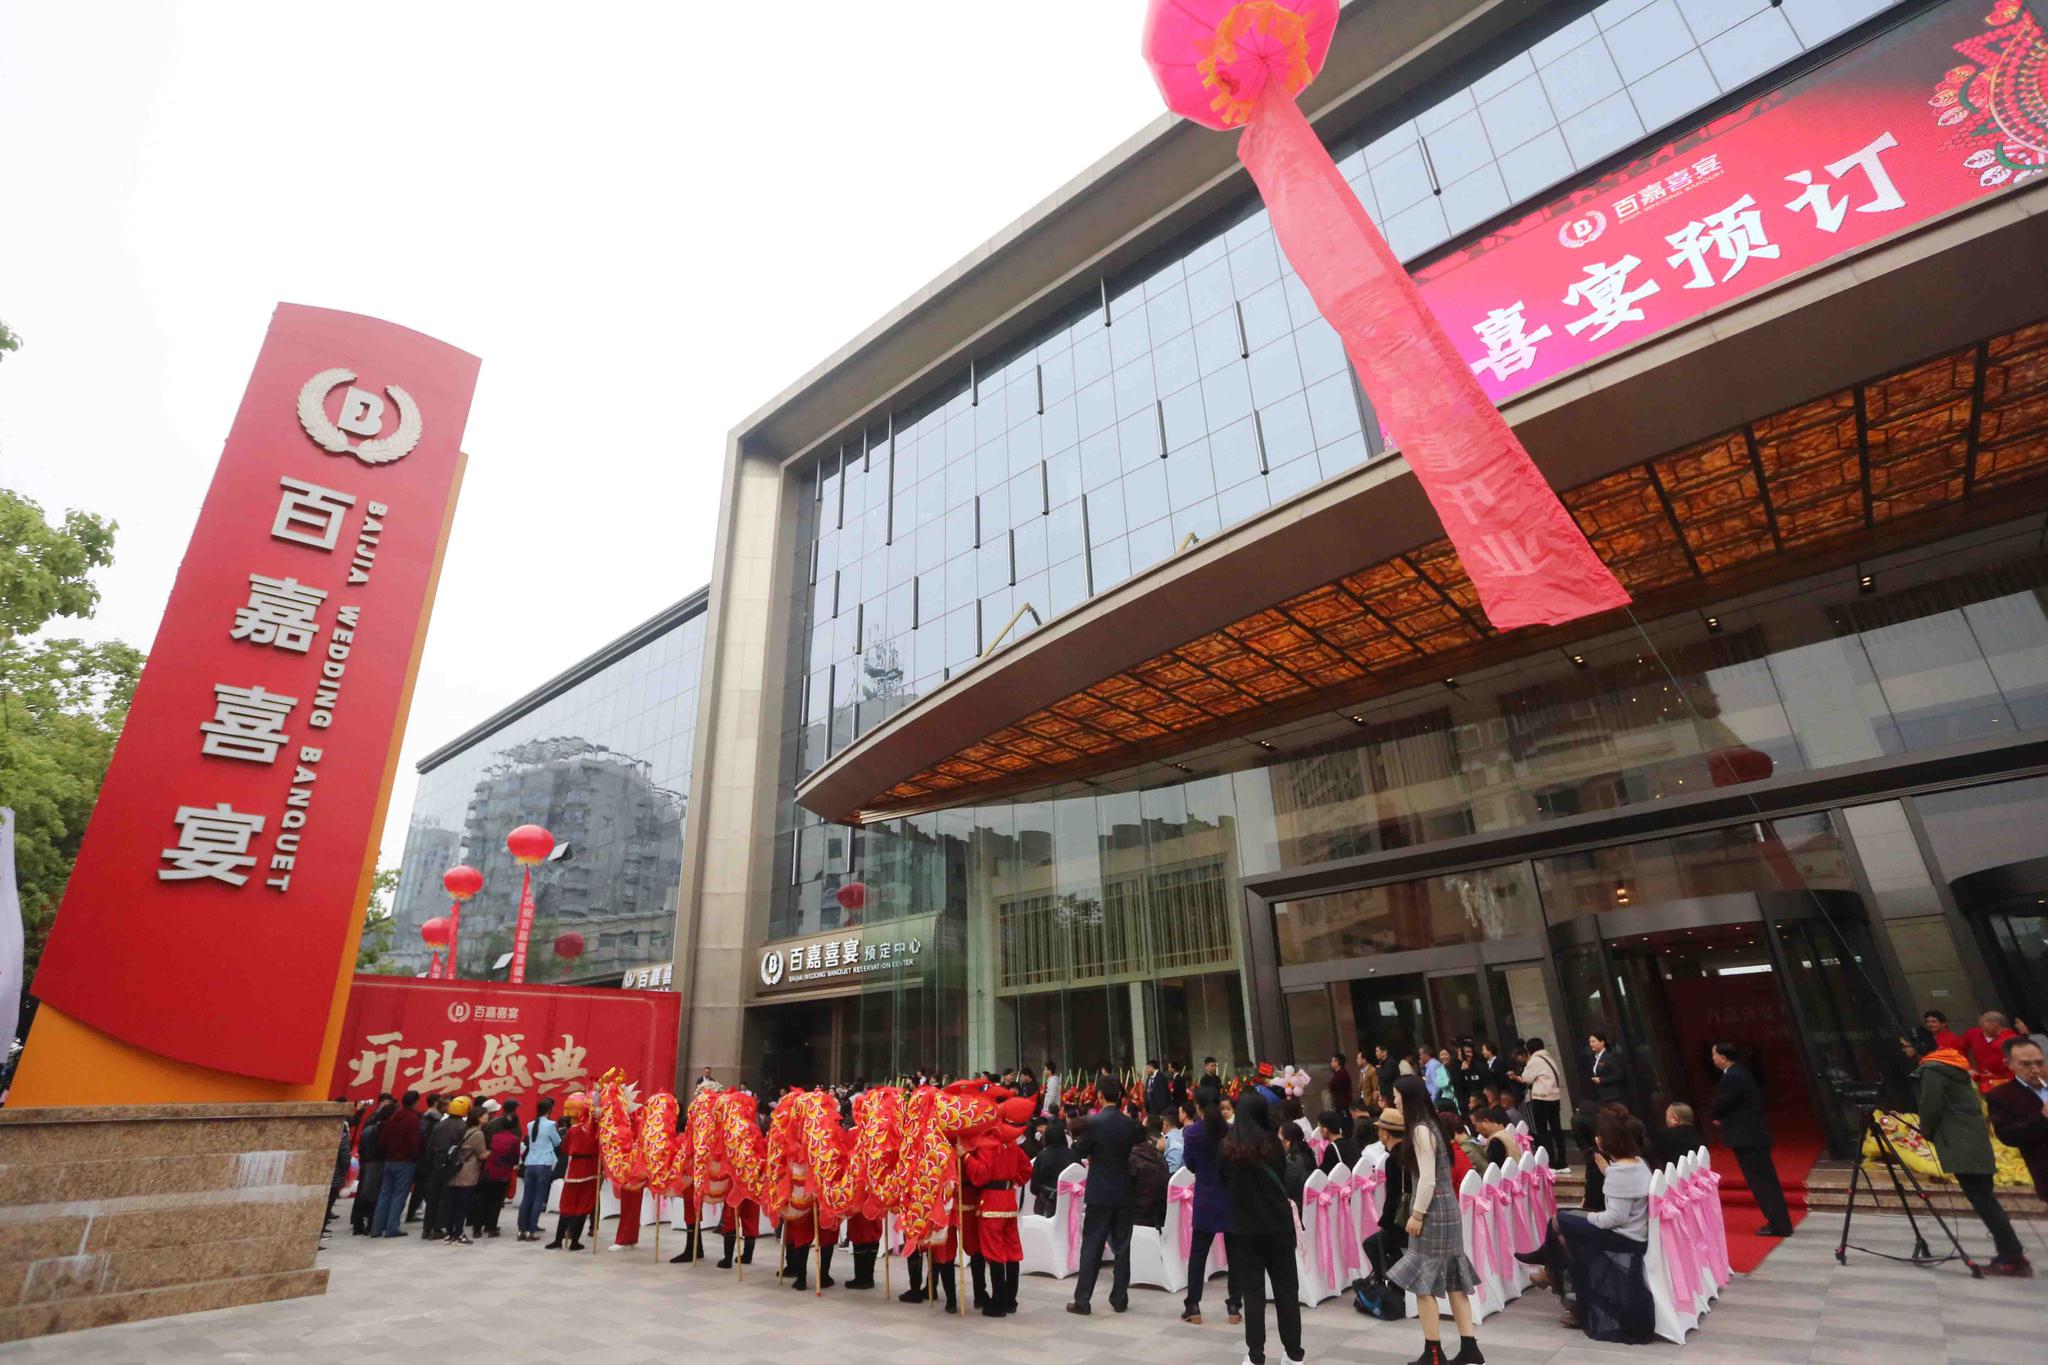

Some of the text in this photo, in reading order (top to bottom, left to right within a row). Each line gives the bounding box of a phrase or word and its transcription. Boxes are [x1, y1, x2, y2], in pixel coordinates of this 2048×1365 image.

[1611, 154, 1721, 218] 百嘉喜宴
[1470, 131, 1907, 382] 喜宴预订
[157, 475, 357, 887] 百嘉喜宴
[266, 500, 389, 892] BAIJIA WEDDING BANQUET
[789, 937, 921, 972] 百嘉喜宴 预定中心
[474, 1005, 520, 1019] 百嘉喜宴
[348, 1031, 589, 1098] 开业盛典
